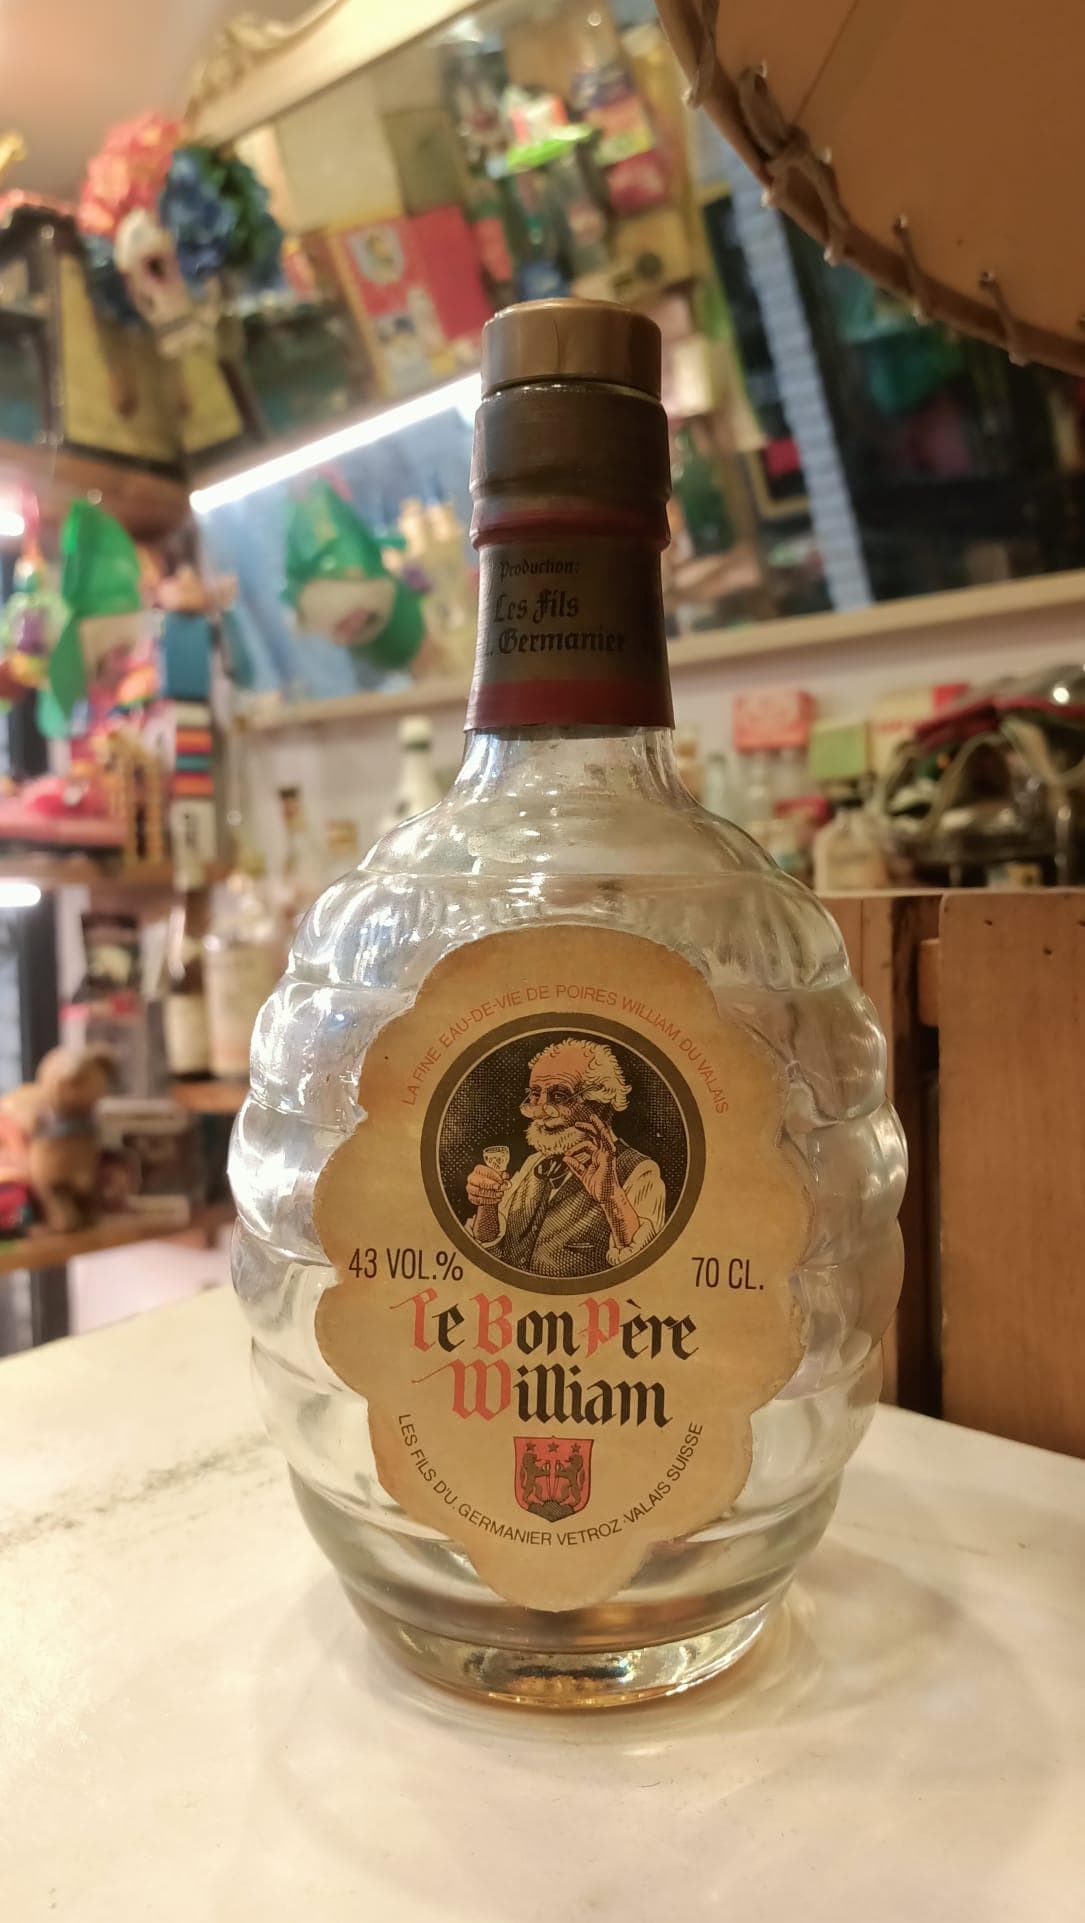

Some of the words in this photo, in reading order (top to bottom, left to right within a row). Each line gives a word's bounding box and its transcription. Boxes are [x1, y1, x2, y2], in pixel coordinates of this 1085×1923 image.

[500, 560, 580, 582] Production:
[494, 594, 528, 622] Les
[532, 589, 580, 624] Fils
[499, 626, 626, 655] Germanier
[401, 1085, 420, 1106] LA
[412, 1047, 442, 1083] FINE
[439, 991, 523, 1048] EAU-DE-VIE
[526, 985, 550, 1001] DE
[556, 984, 618, 1006] POIRES
[622, 996, 681, 1041] WILLIAM
[678, 1038, 702, 1061] DU
[697, 1060, 729, 1114] VALAIS
[348, 1248, 377, 1278] 43
[386, 1248, 464, 1281] VOL.%
[691, 1257, 719, 1288] 70
[728, 1258, 764, 1290] CL.
[389, 1288, 465, 1352] Le
[469, 1293, 580, 1357] Bon
[577, 1297, 699, 1361] Père
[411, 1358, 673, 1428] William
[398, 1414, 418, 1447] LES
[410, 1449, 437, 1482] FILS
[458, 1503, 552, 1546] GERMANIER
[556, 1519, 622, 1546] VETROZ
[666, 1422, 703, 1482] SUISSE
